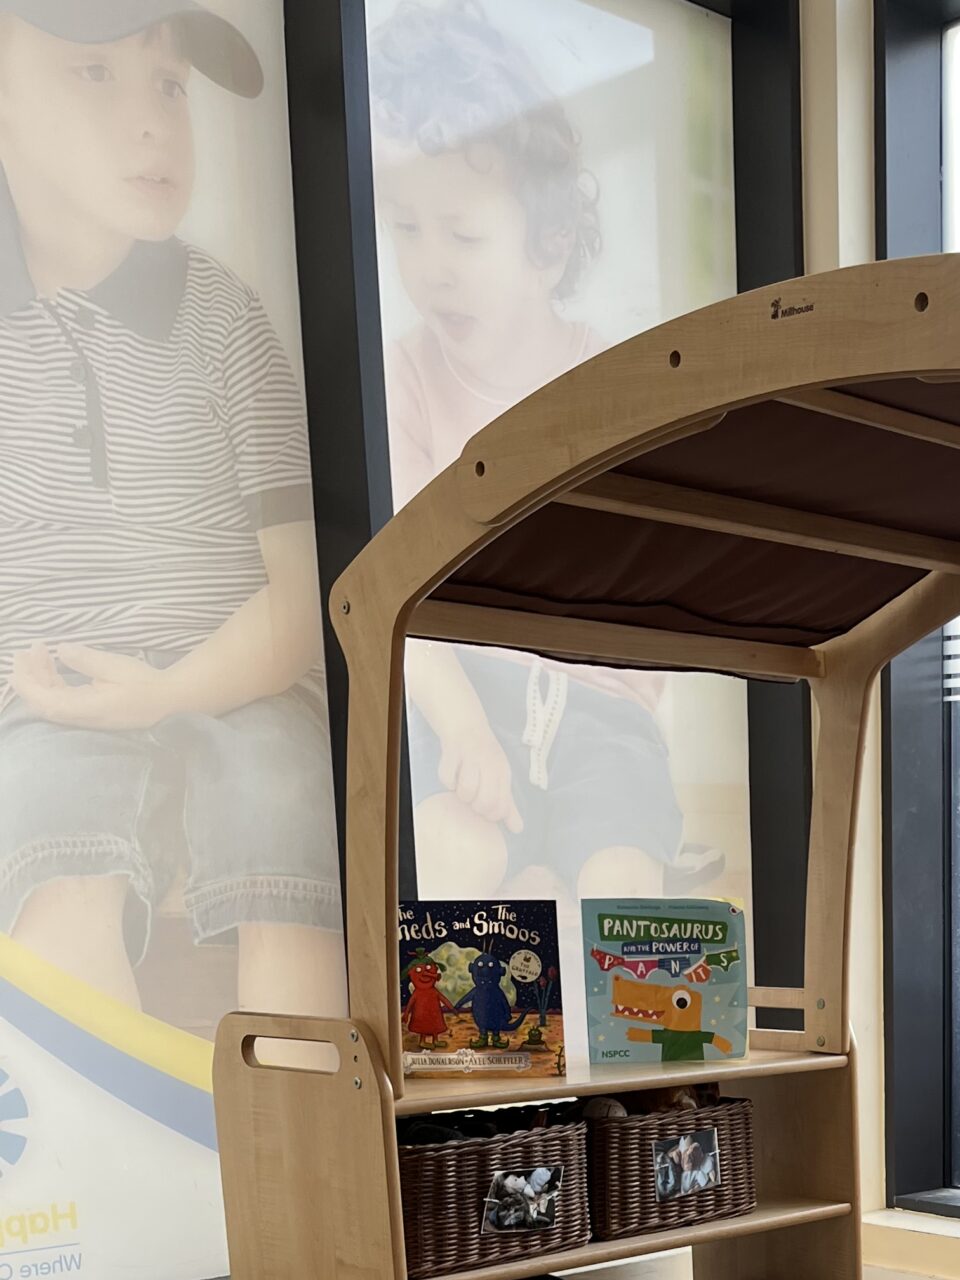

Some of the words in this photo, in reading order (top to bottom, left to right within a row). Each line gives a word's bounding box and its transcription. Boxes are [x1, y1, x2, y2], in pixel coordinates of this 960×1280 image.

[491, 904, 517, 921] The
[452, 918, 471, 931] and
[473, 911, 541, 945] Smoos
[603, 918, 724, 940] PANTOSAURUS
[652, 942, 689, 953] POWER
[601, 1050, 630, 1058] NSPCC
